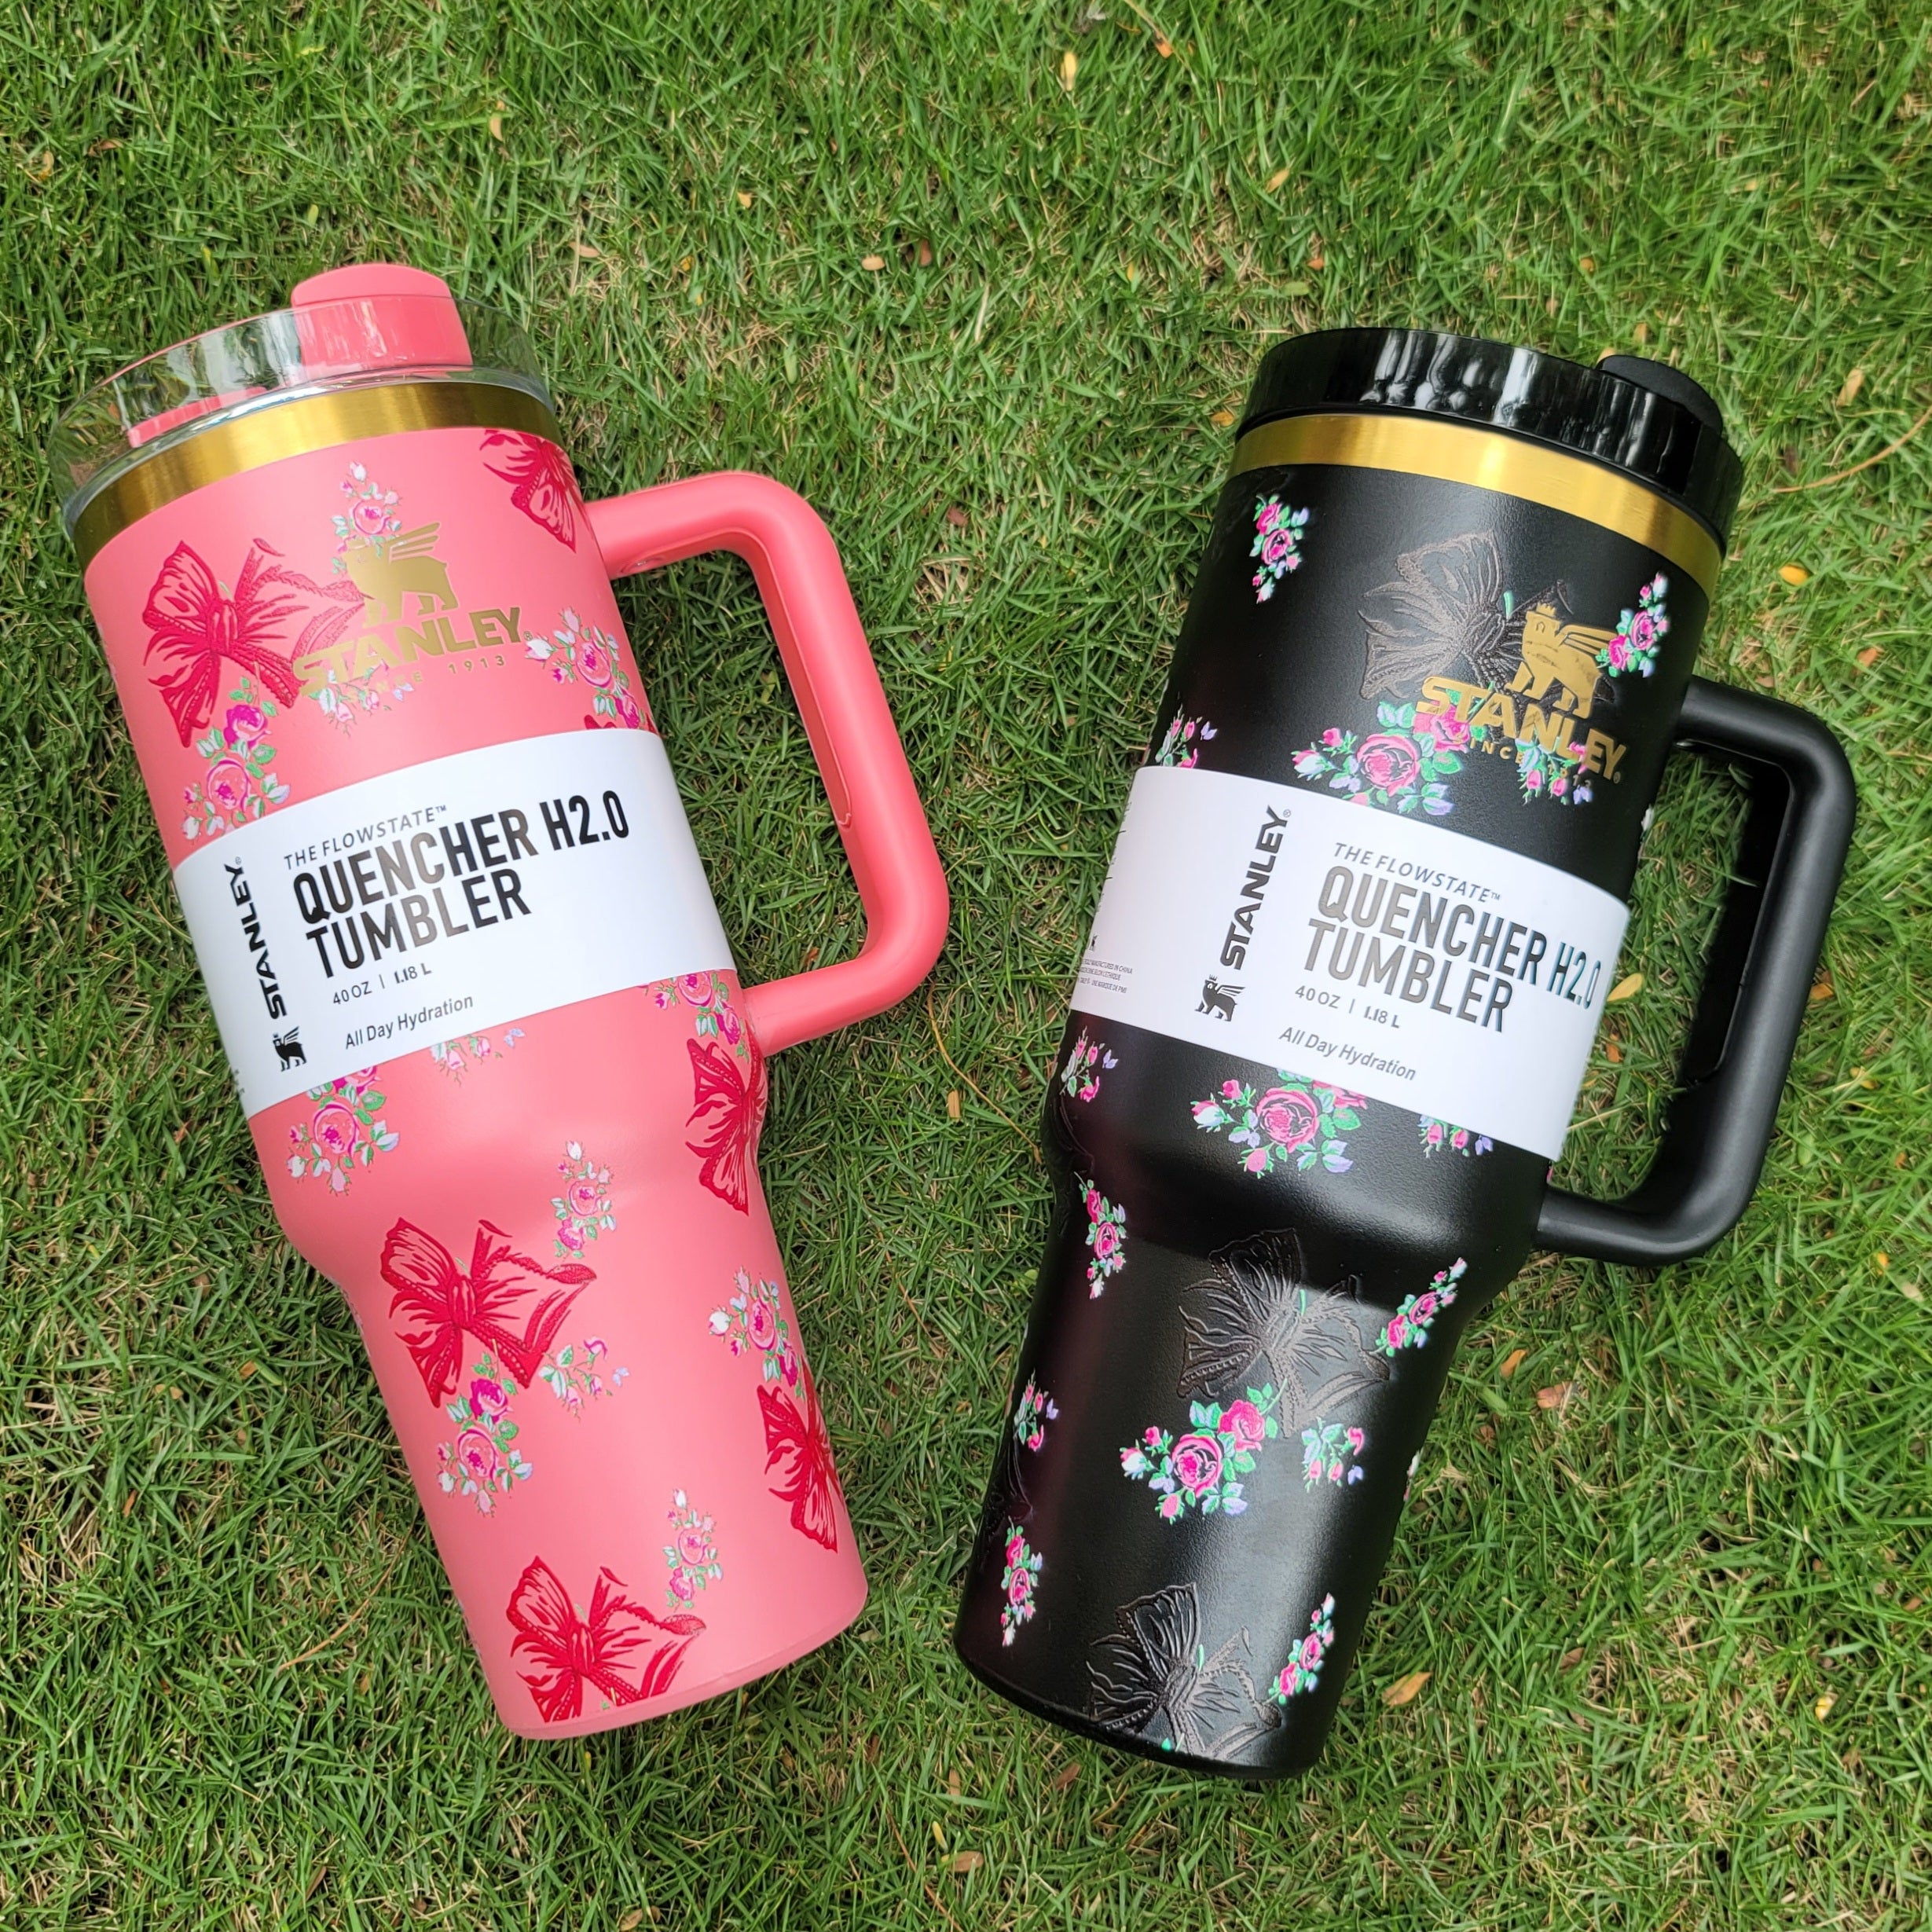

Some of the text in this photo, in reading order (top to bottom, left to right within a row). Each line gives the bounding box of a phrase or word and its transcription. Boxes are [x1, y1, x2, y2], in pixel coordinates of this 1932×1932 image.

[448, 654, 505, 675] 1913
[284, 845, 317, 870] THE
[292, 790, 629, 925] QUENCHER H2.0
[1334, 842, 1373, 866] THE
[306, 868, 533, 979] TUMBLER
[1317, 865, 1602, 1010] QUENCHER H2.0
[394, 966, 418, 984] 1.18
[421, 962, 432, 976] L
[1119, 965, 1133, 974] CHINA
[1303, 918, 1513, 1034] TUMBLER
[346, 995, 474, 1050] All Day Hydration
[1363, 1006, 1388, 1025] 1.18
[1391, 1015, 1400, 1029] L
[1278, 1027, 1417, 1081] All Day Hydration
